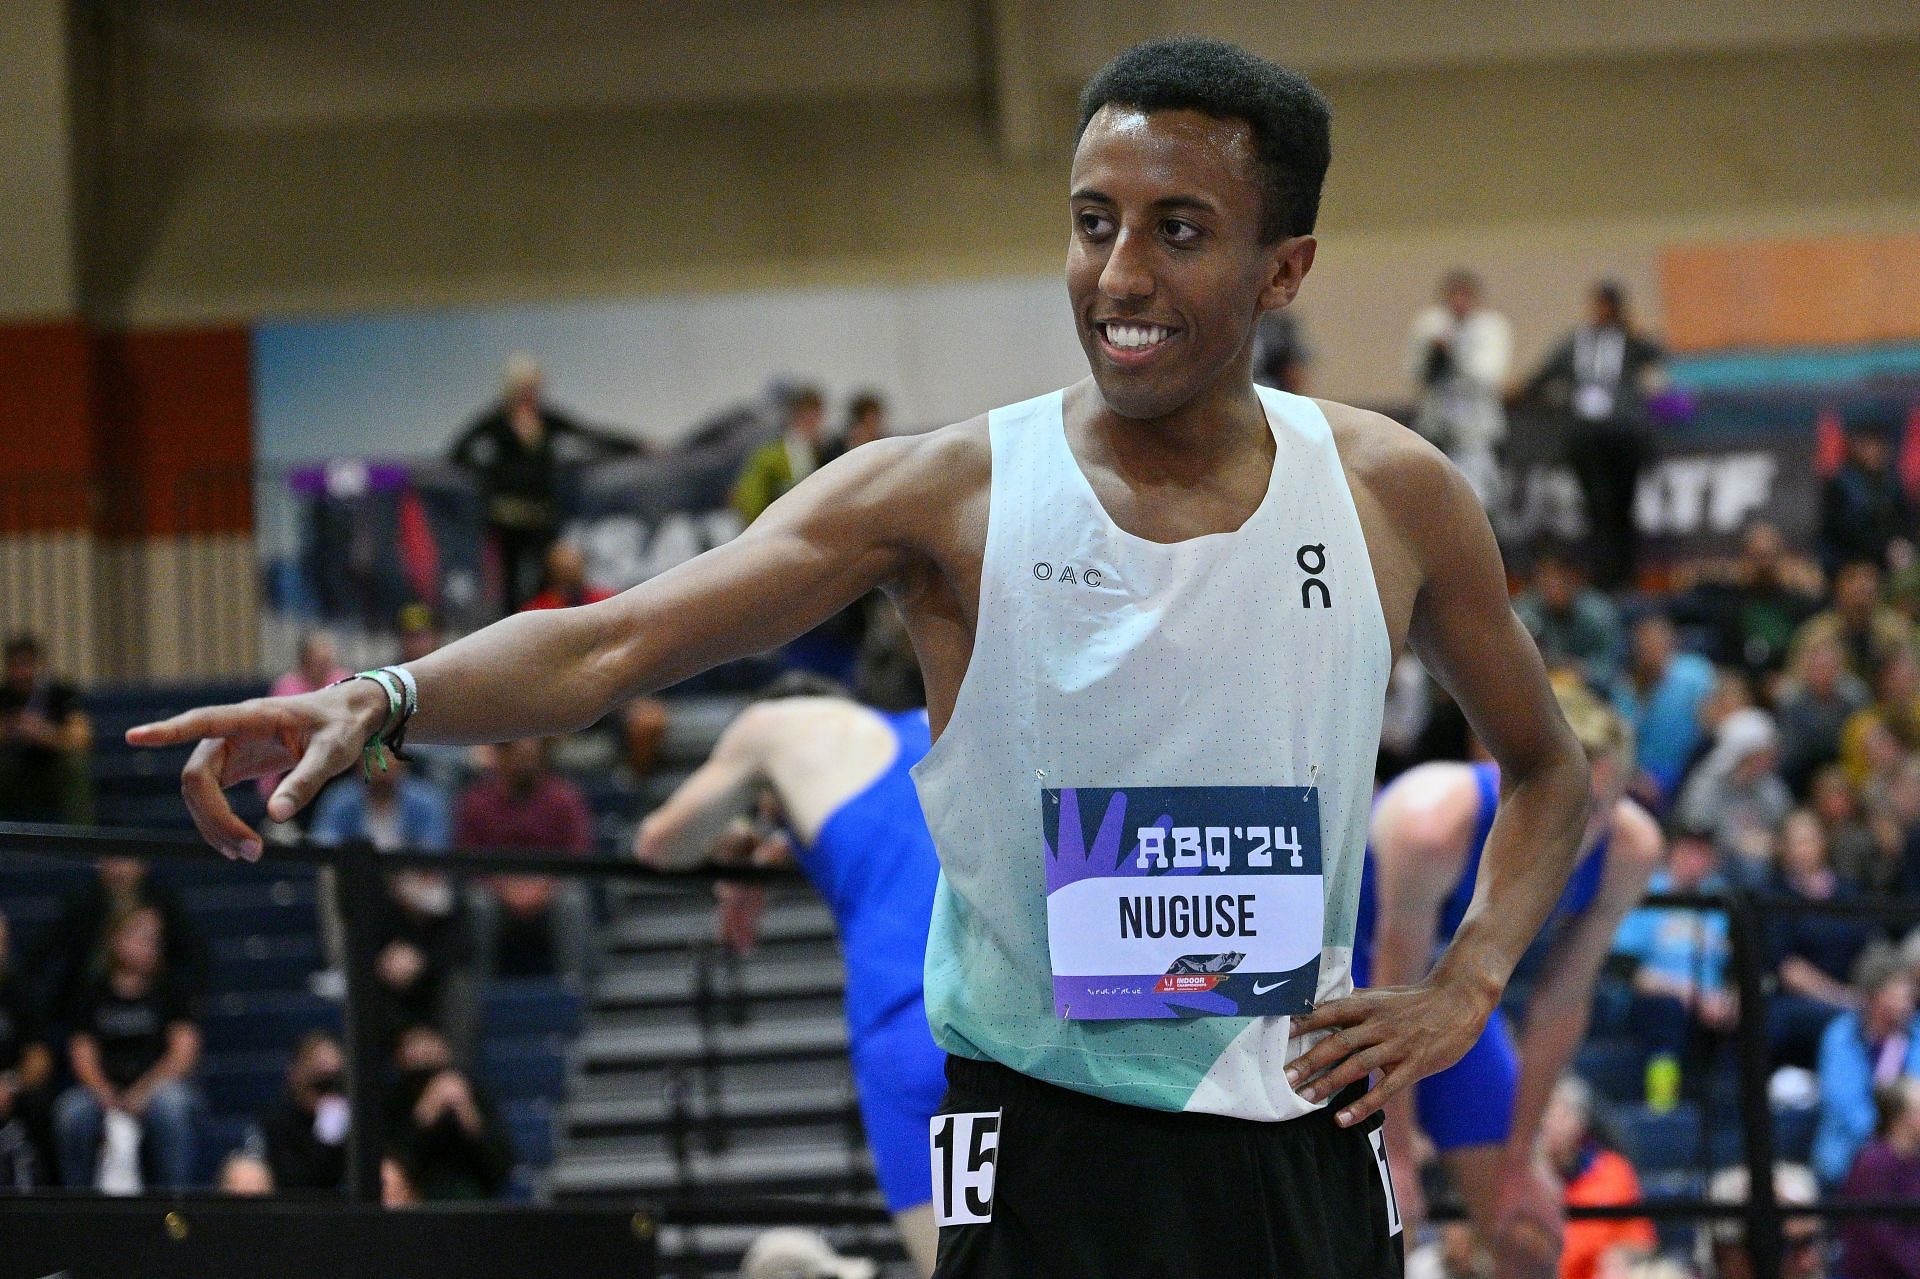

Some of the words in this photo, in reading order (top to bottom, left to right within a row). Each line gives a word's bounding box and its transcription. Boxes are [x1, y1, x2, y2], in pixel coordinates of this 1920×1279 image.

[1033, 561, 1102, 588] OAC
[1136, 826, 1303, 873] ABQ'24
[1119, 894, 1257, 939] NUGUSE
[934, 1116, 1000, 1218] 15
